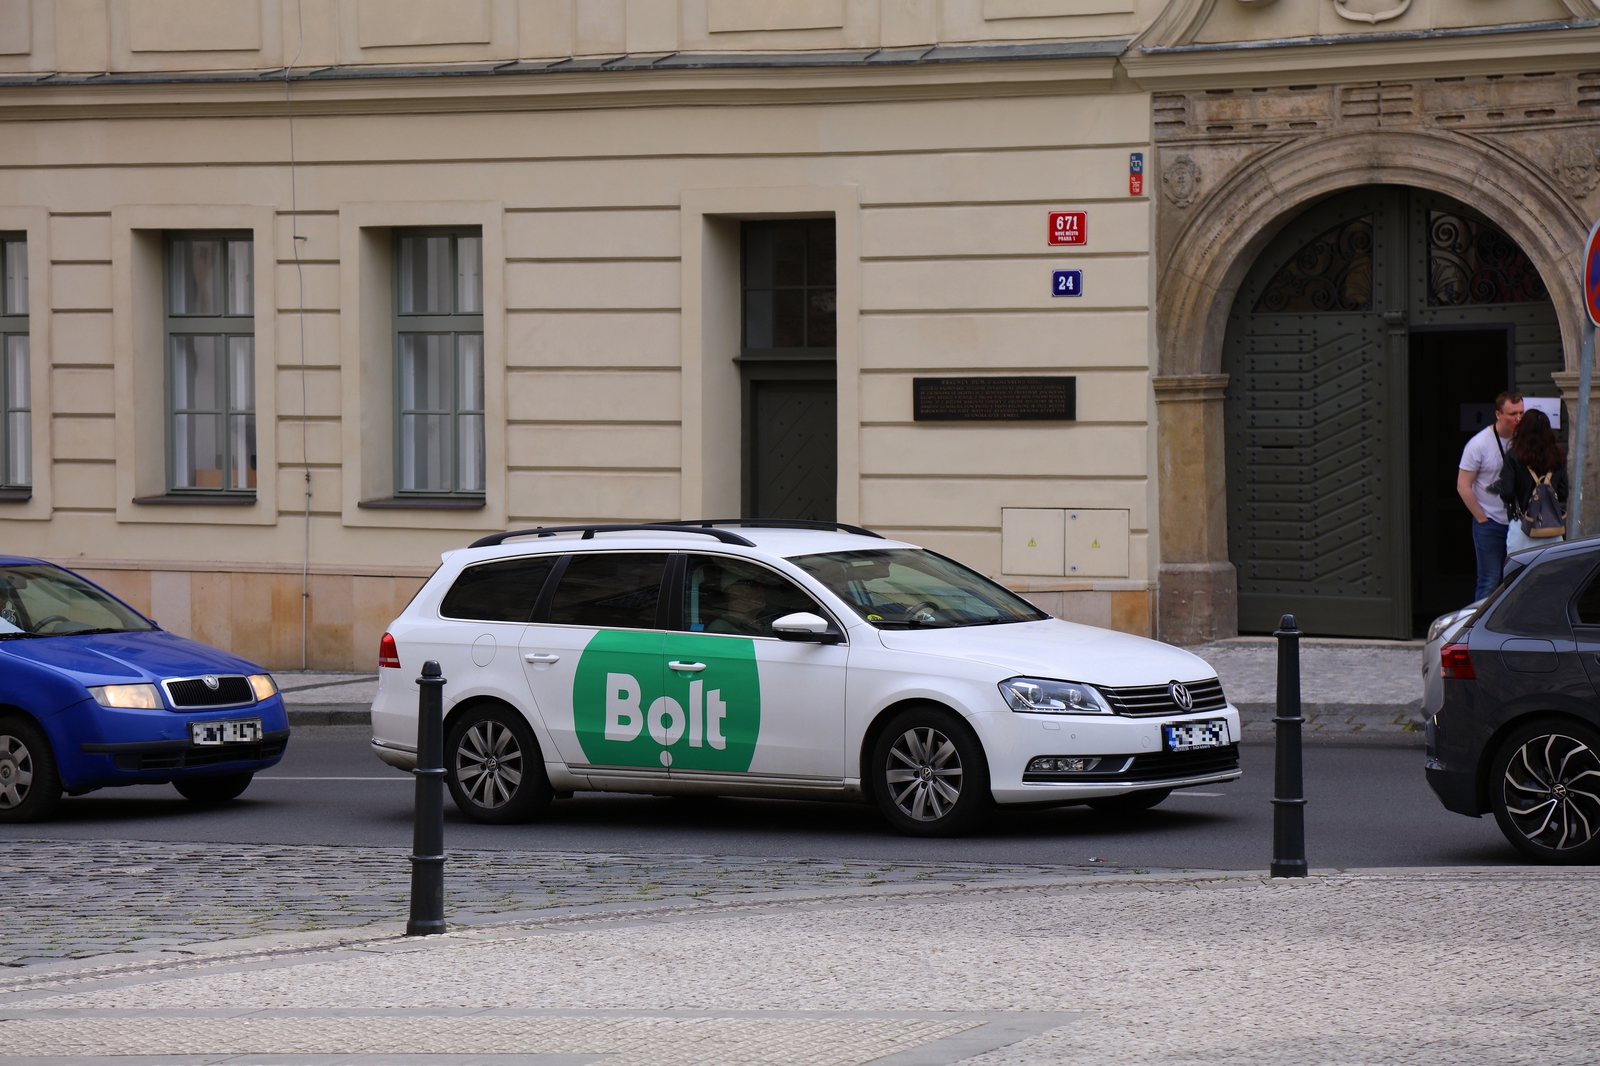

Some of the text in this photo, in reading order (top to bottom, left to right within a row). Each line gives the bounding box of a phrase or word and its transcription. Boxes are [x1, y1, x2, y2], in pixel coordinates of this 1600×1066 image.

[1056, 215, 1078, 230] 671
[1058, 275, 1074, 290] 24
[605, 672, 727, 766] Bolt
